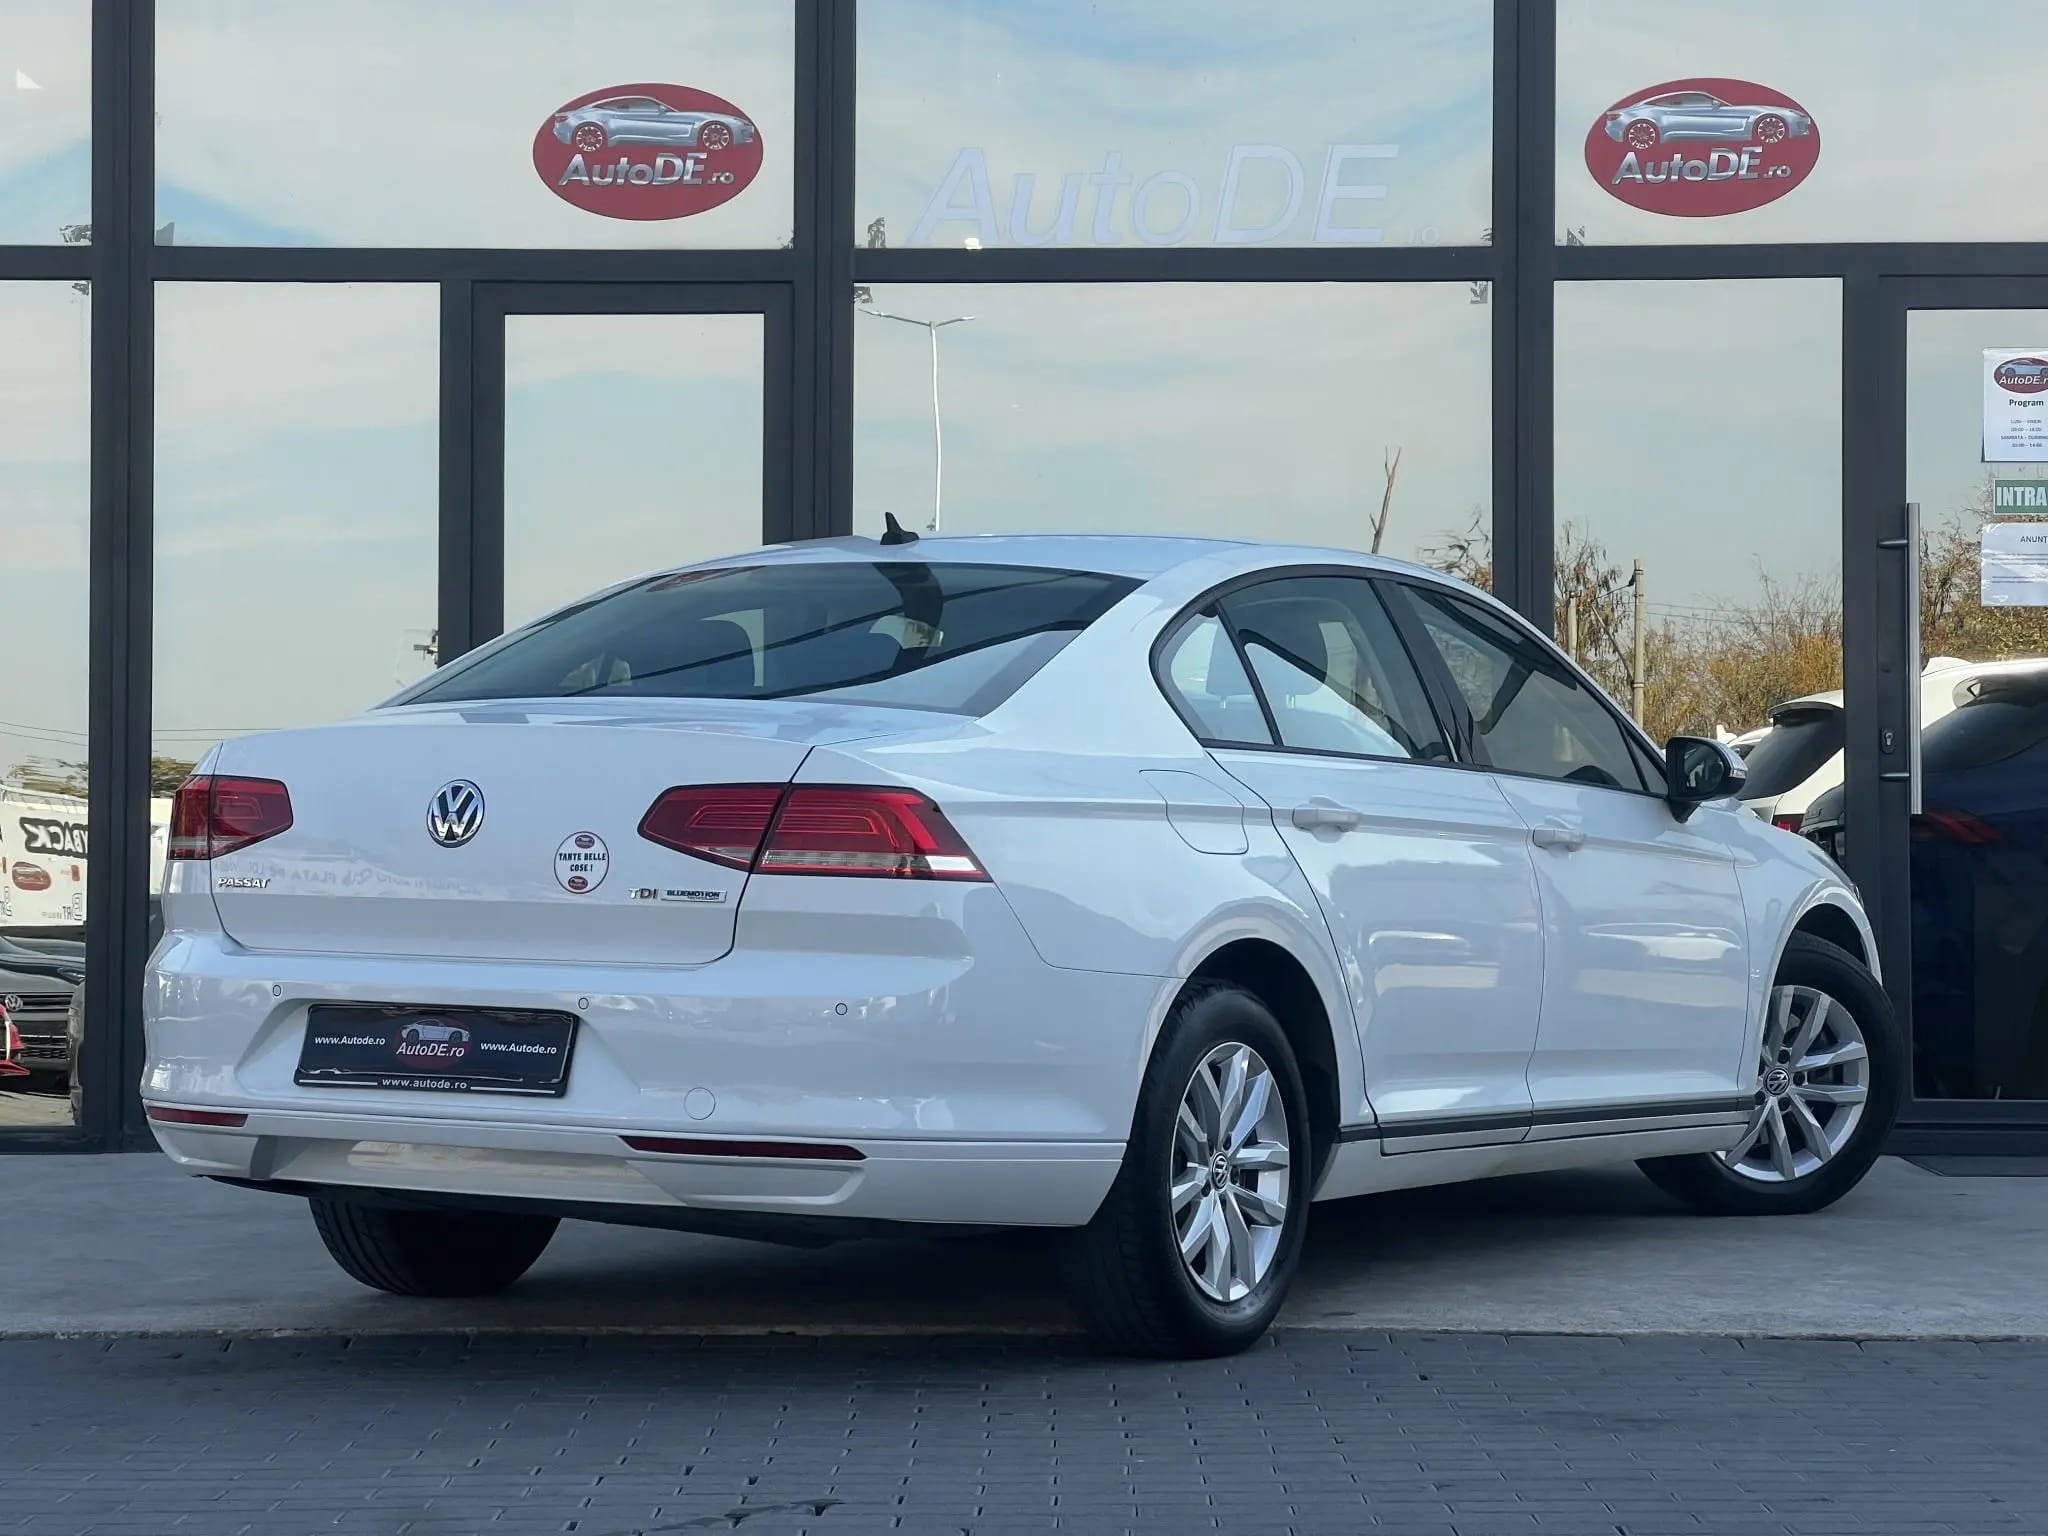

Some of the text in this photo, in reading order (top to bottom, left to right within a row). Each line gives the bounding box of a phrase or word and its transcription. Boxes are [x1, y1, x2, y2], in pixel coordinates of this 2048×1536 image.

[2008, 398, 2044, 408] Program
[1996, 486, 2048, 506] INTRA
[558, 852, 607, 861] TANTE BELLE
[569, 863, 588, 872] COSE
[217, 876, 271, 889] PASSAT
[628, 888, 721, 900] TDI BLUEMOTION
[314, 1034, 386, 1046] www.Autode.ro
[396, 1041, 465, 1057] AutoDE.ro
[480, 1040, 557, 1055] www.Autode.ro
[382, 1076, 468, 1090] www.autode.ro
